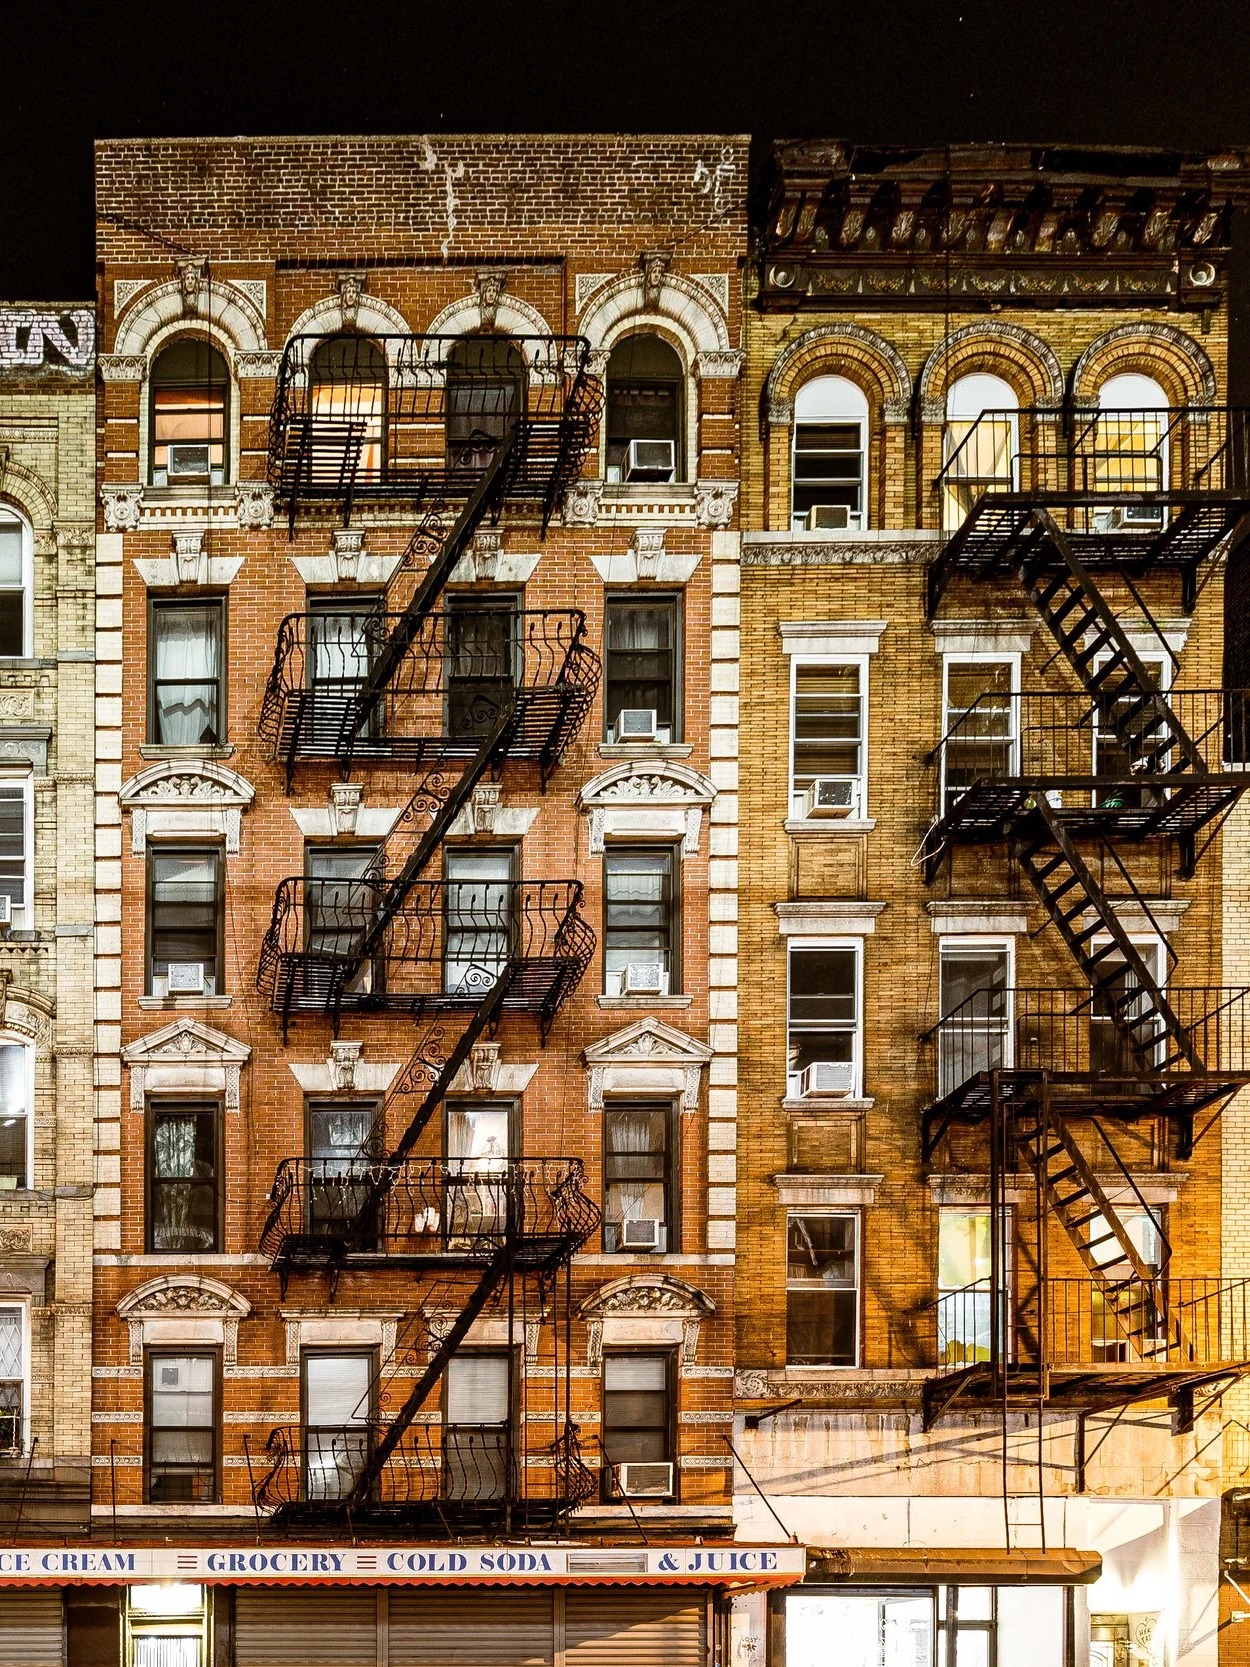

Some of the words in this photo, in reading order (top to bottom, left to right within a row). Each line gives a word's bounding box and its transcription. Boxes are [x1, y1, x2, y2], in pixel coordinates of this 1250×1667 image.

[41, 1554, 136, 1571] CREAM
[207, 1553, 347, 1571] GROCERY
[387, 1553, 467, 1571] COLD
[480, 1553, 552, 1571] SODA
[657, 1553, 680, 1571] &
[688, 1552, 778, 1571] JUICE
